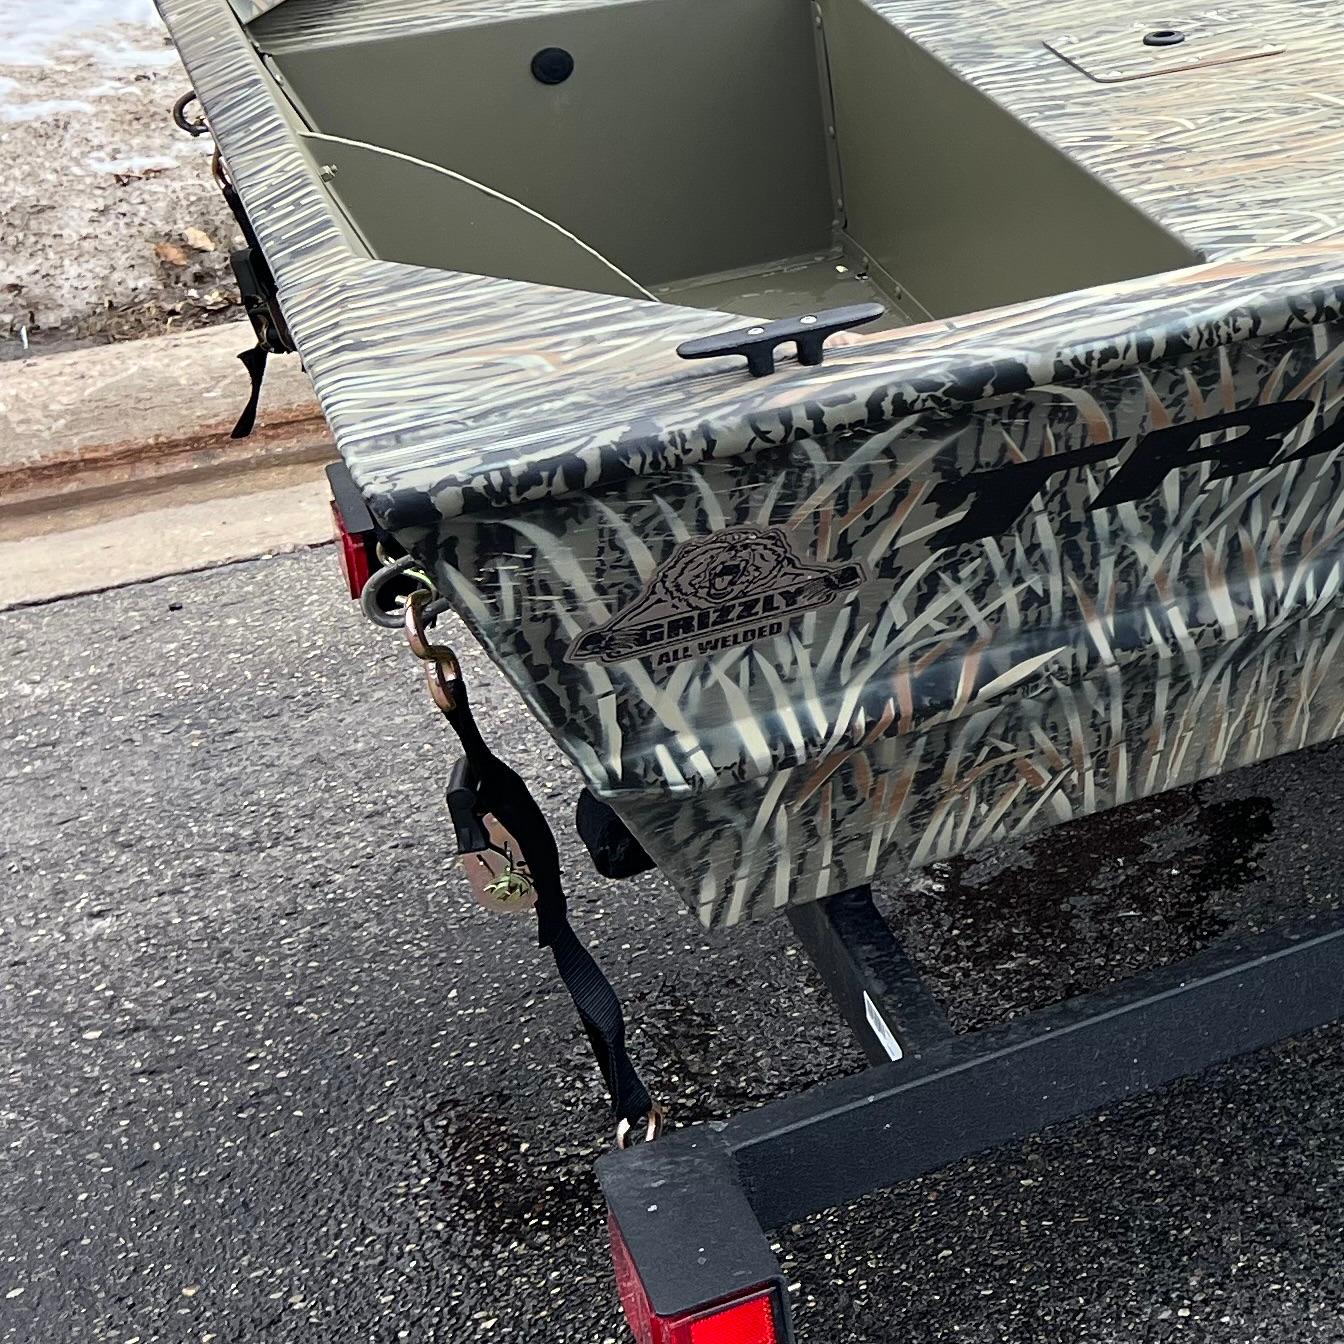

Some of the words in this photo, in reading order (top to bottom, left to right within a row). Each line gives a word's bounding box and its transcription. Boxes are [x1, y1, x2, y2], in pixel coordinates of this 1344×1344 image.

[639, 589, 800, 646] GRIZZLY
[656, 645, 692, 666] ALL
[696, 621, 783, 654] WELDED
